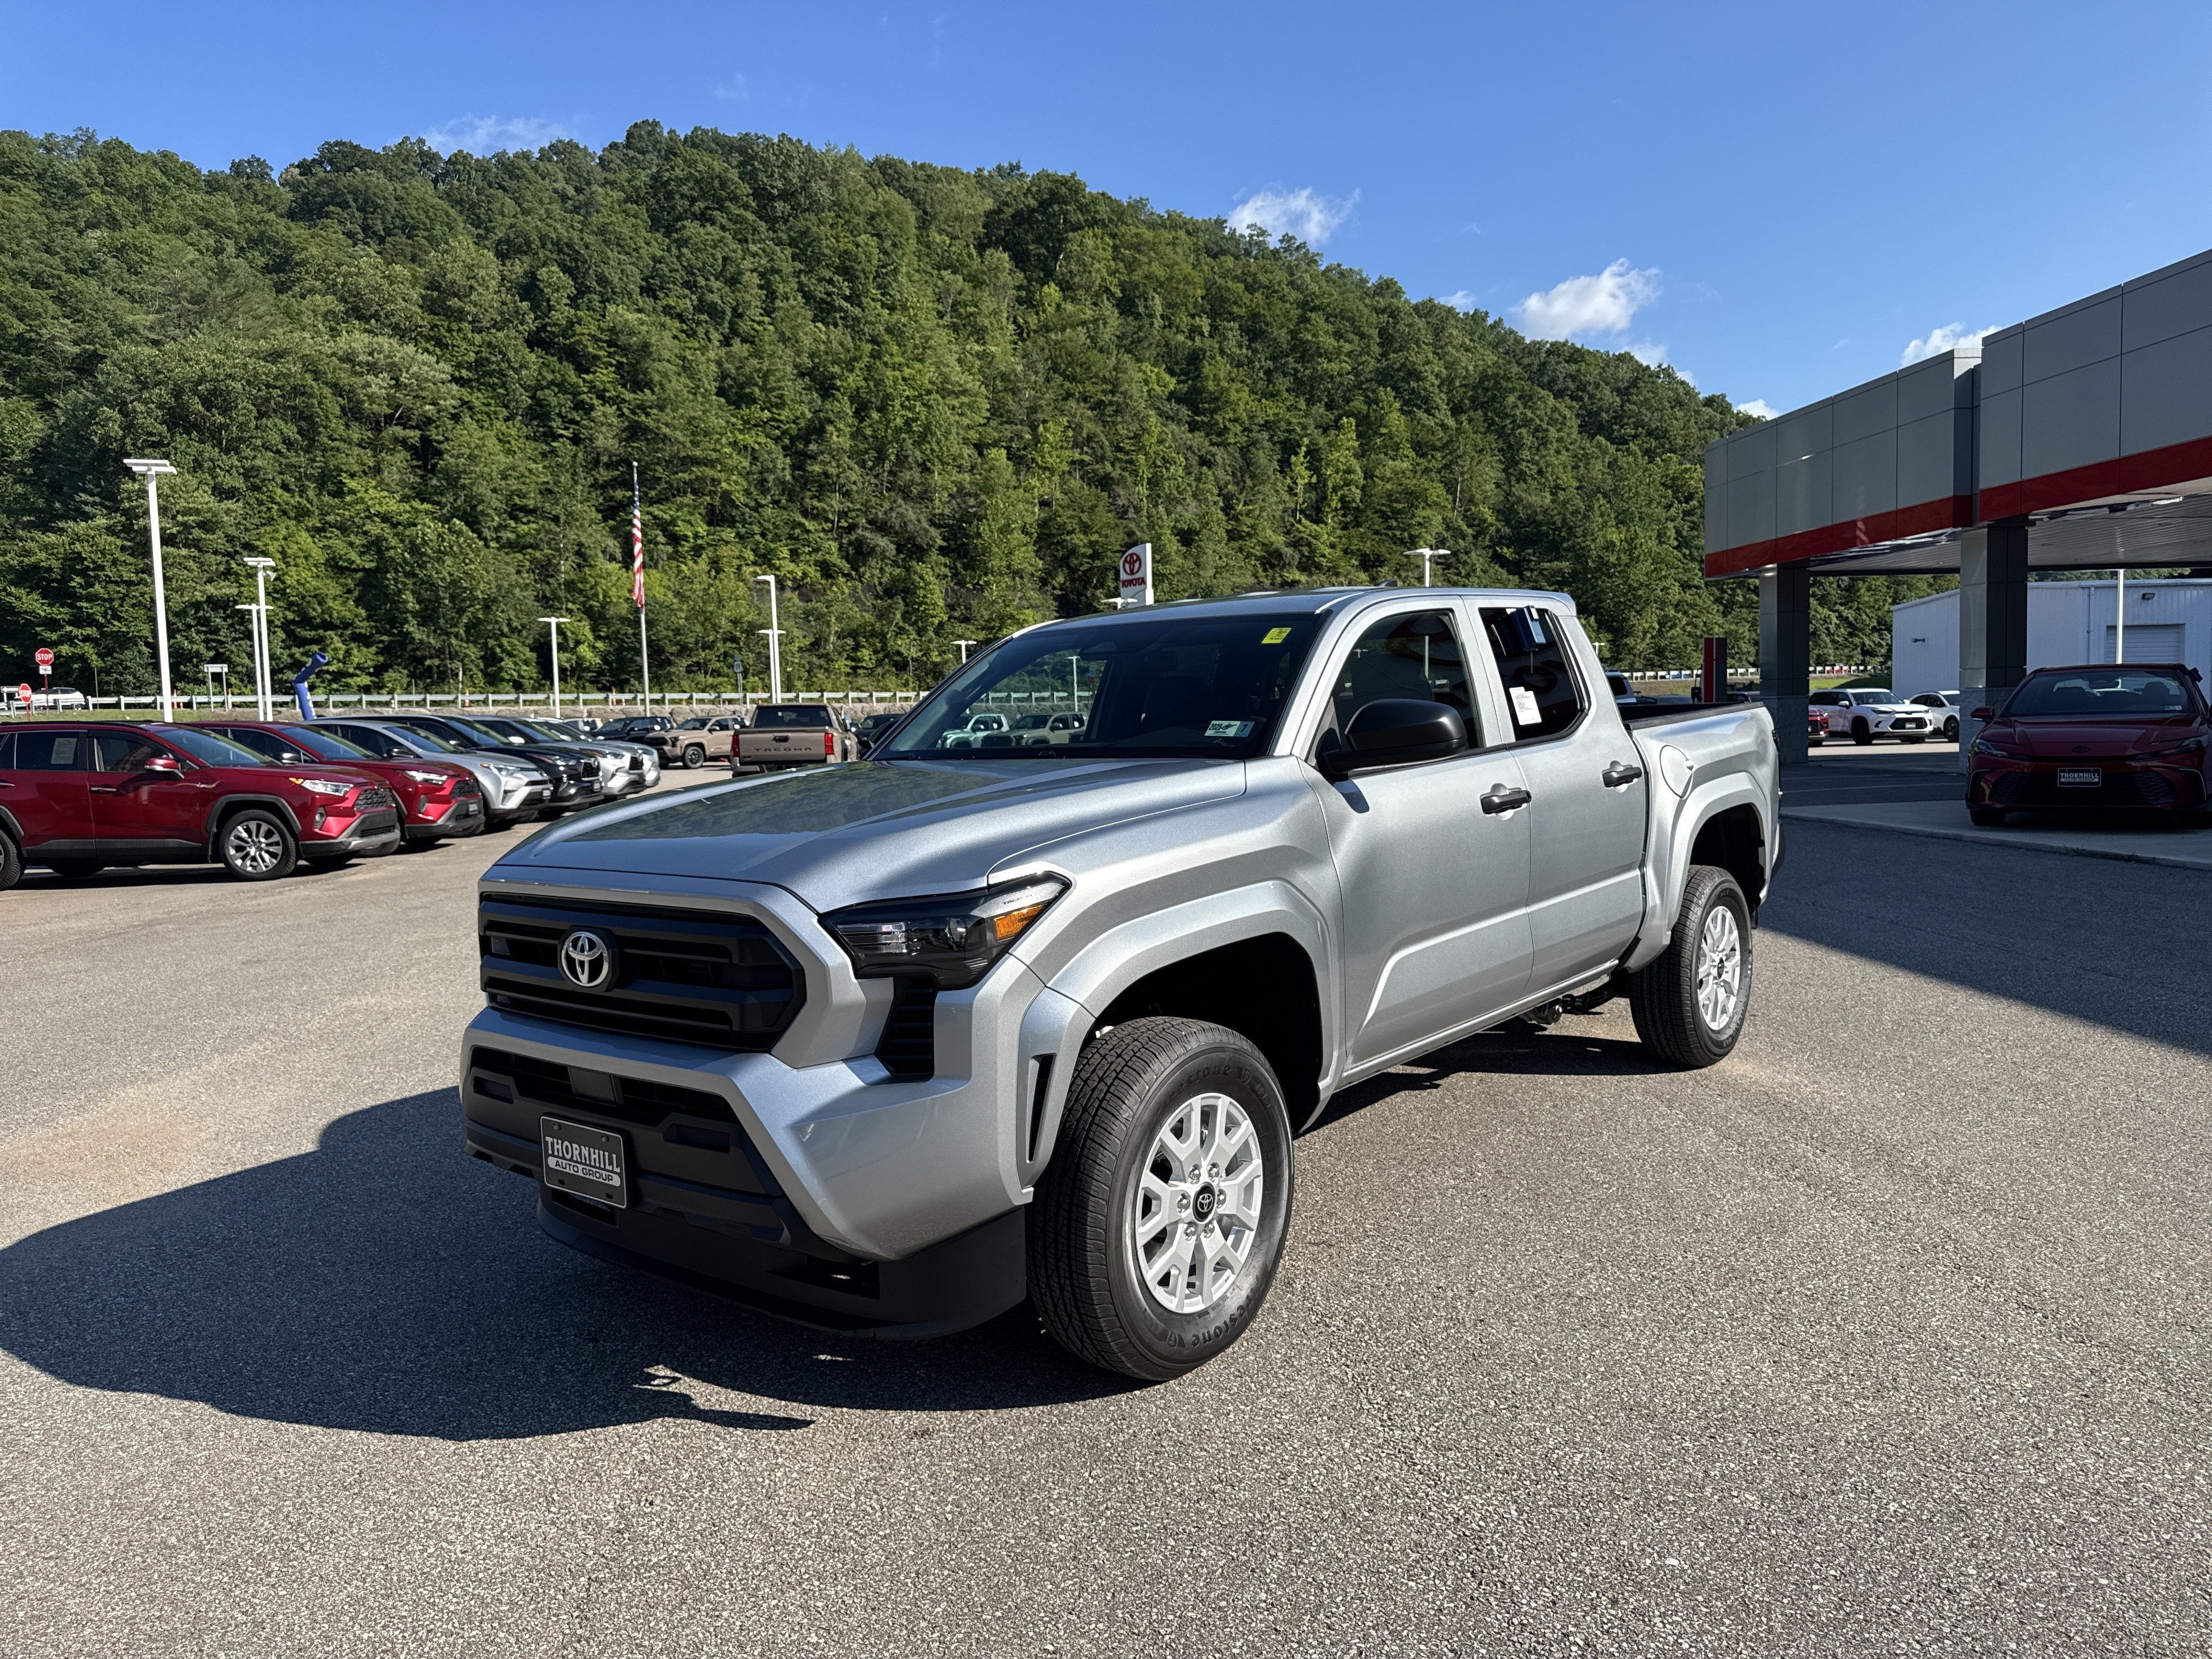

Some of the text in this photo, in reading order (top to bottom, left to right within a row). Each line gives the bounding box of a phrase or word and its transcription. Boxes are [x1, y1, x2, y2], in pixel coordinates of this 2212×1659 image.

[1121, 577, 1146, 588] TOYOTA
[1240, 724, 1248, 733] 7
[545, 1136, 621, 1173] THORNHILL
[555, 1160, 613, 1182] AUTO GROUP
